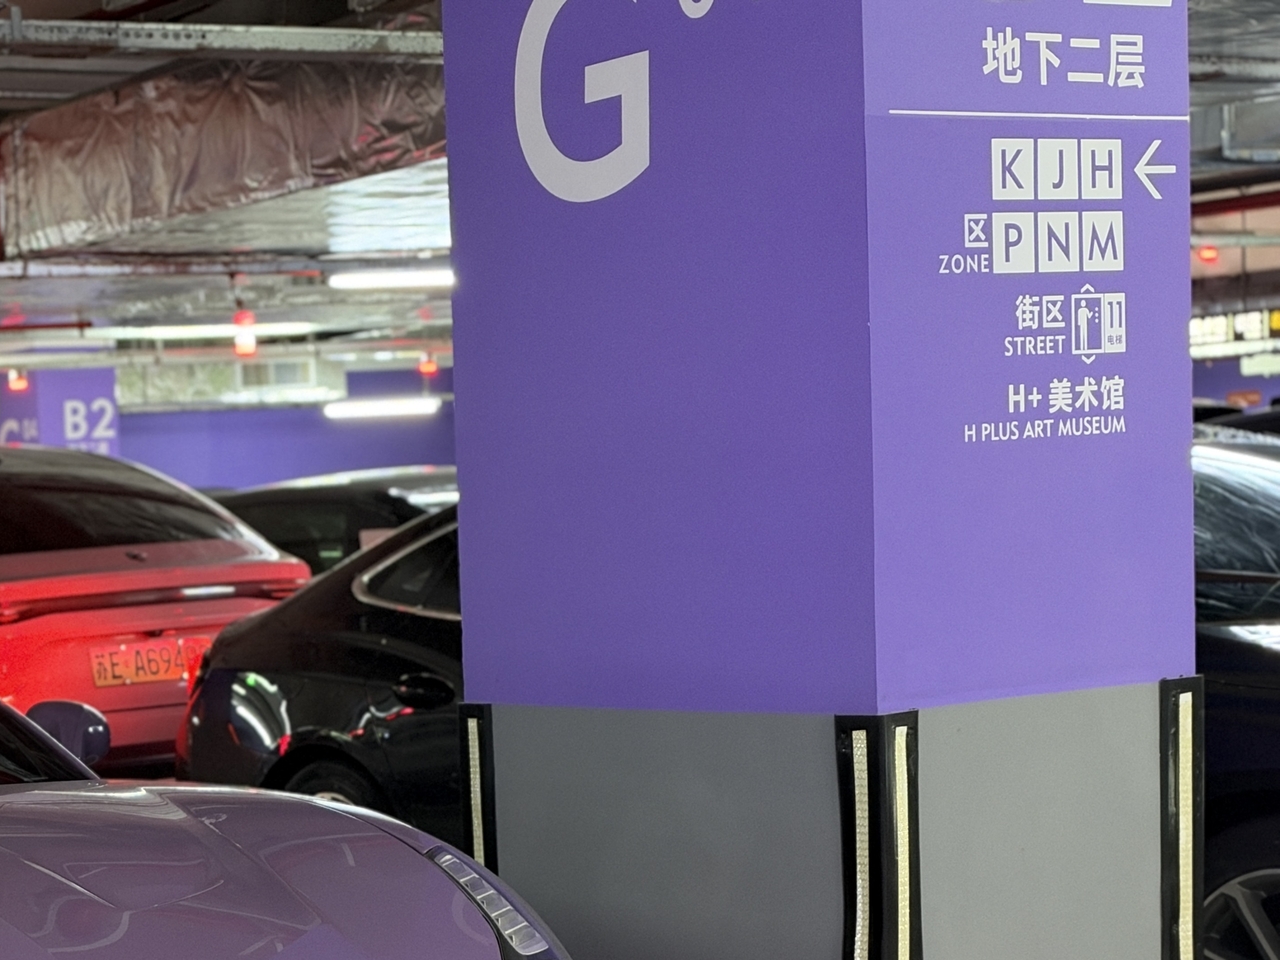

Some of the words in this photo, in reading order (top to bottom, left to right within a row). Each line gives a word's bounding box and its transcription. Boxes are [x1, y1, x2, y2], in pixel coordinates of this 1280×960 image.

[982, 27, 1146, 89] 地下二层
[964, 213, 989, 248] 区
[938, 254, 990, 274] ZONE
[1015, 294, 1066, 330] 街区
[1004, 335, 1067, 357] STREET
[1048, 375, 1125, 414] 美术馆
[63, 397, 116, 440] B2
[964, 424, 977, 443] H
[981, 421, 1020, 442] PLUS
[1022, 418, 1055, 440] ART
[1058, 415, 1127, 437] MUSEUM
